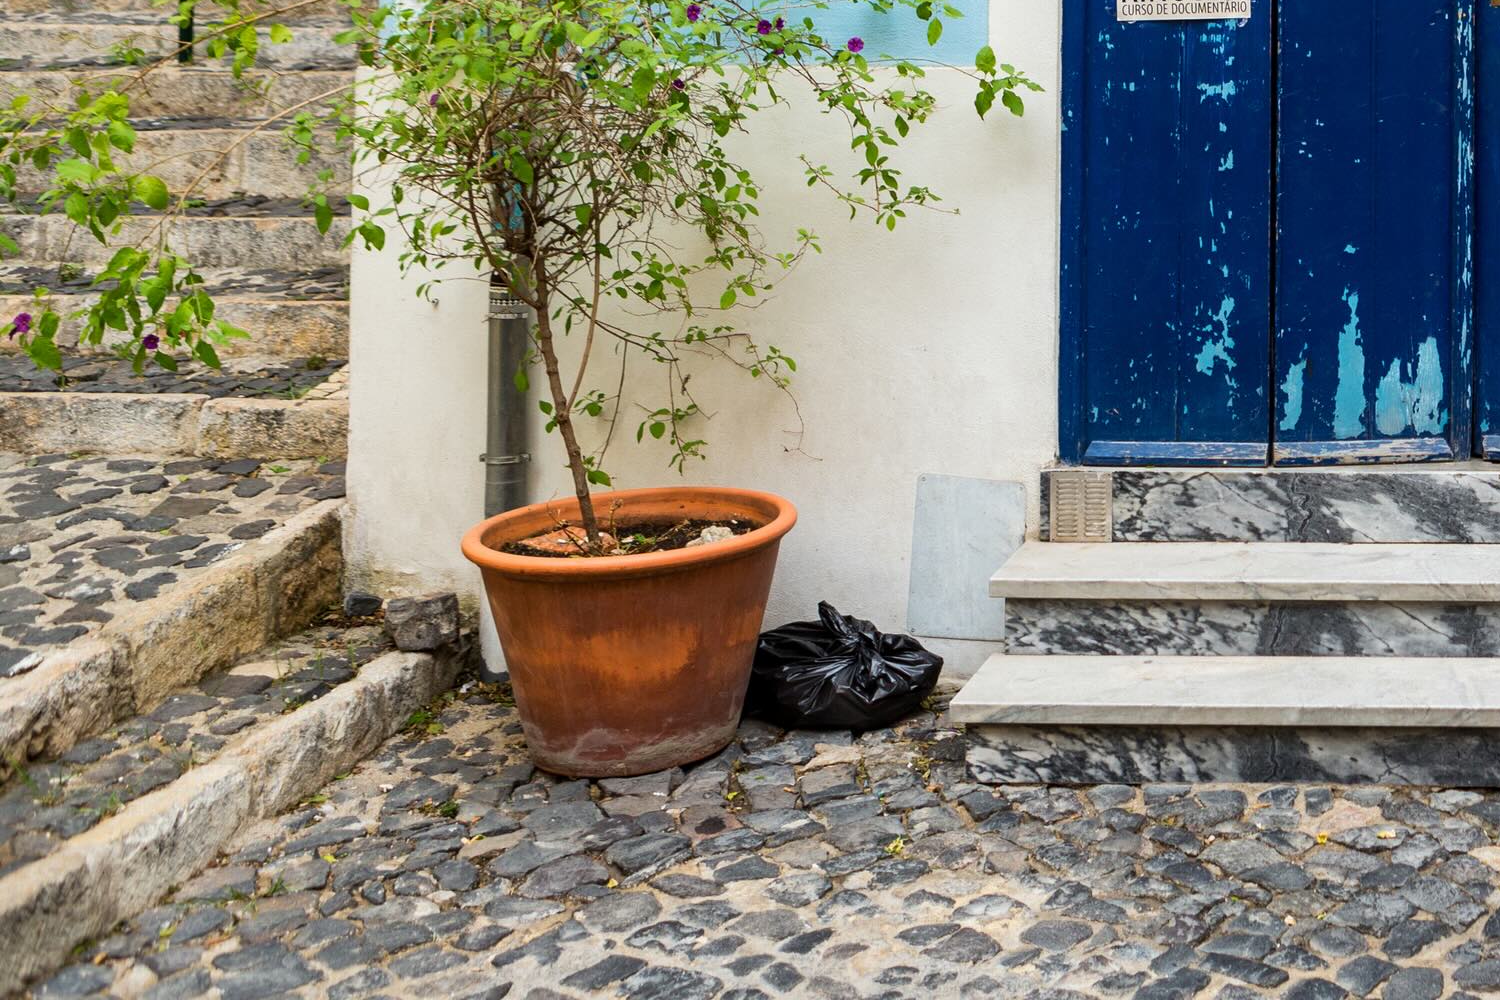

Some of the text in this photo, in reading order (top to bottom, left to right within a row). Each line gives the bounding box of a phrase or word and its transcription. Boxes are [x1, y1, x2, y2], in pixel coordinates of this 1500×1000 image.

[1121, 0, 1248, 16] CURSO DE DOCUMENTÁRIO
